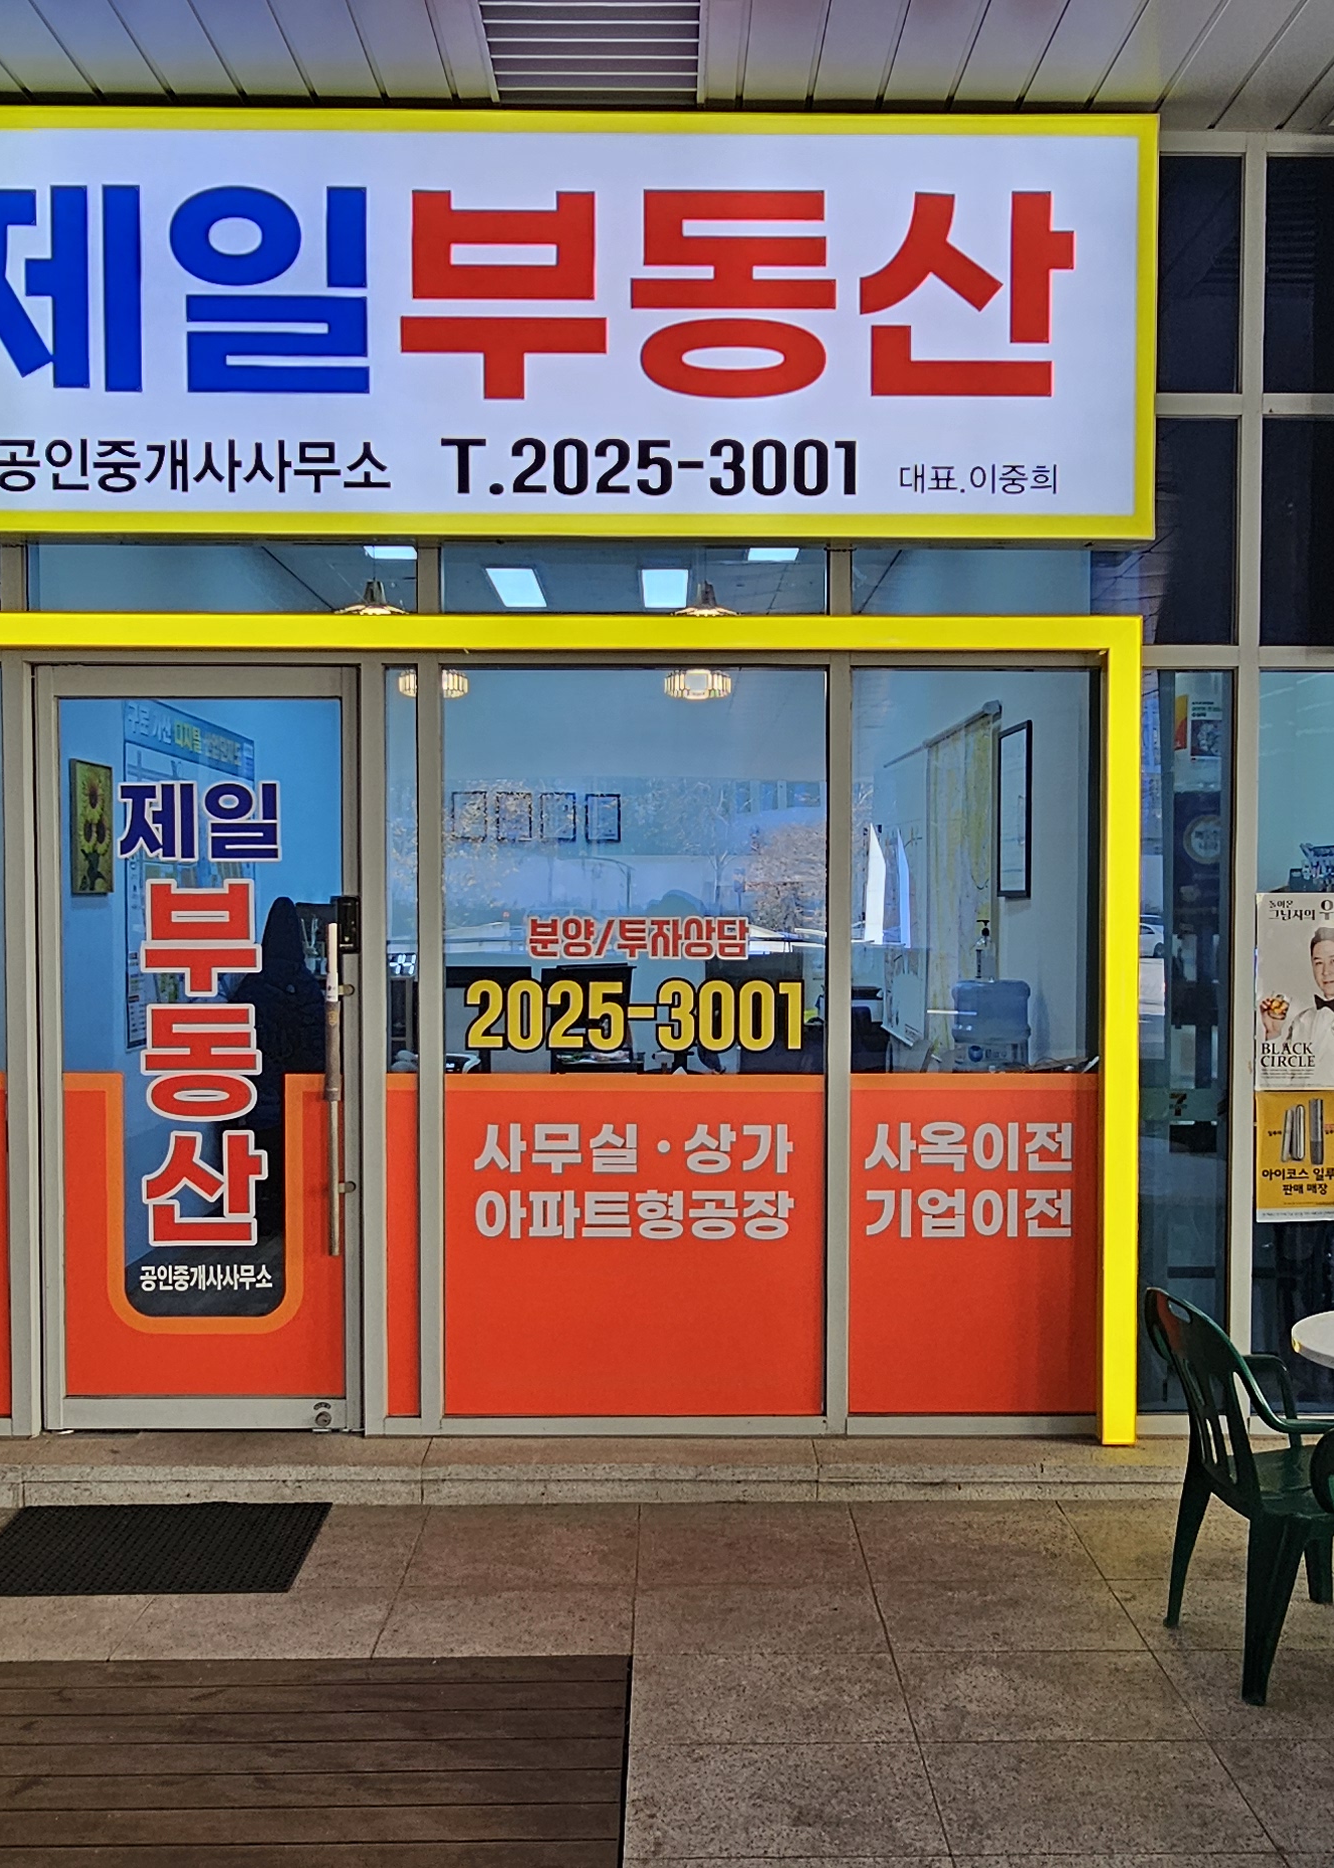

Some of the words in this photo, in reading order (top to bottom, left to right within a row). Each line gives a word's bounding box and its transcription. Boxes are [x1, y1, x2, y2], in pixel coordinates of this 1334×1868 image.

[440, 437, 858, 497] T.2025-3001
[118, 780, 283, 861] 제일
[527, 917, 749, 960] 분양/투자상담
[464, 976, 805, 1053] 2025-3001
[140, 877, 269, 1248] 부동산
[1260, 1055, 1316, 1068] CIRCLE
[1261, 1042, 1314, 1055] BLACK
[474, 1124, 638, 1174] 사무실
[684, 1124, 794, 1174] 상가
[865, 1122, 1073, 1172] 사옥이전
[1261, 1167, 1310, 1181] 아이코스
[1282, 1182, 1305, 1197] 판매
[1306, 1182, 1329, 1197] 매장
[474, 1190, 794, 1241] 아파트형공장
[865, 1189, 1073, 1239] 기업이전
[139, 1263, 274, 1293] 공인중개사사무소
